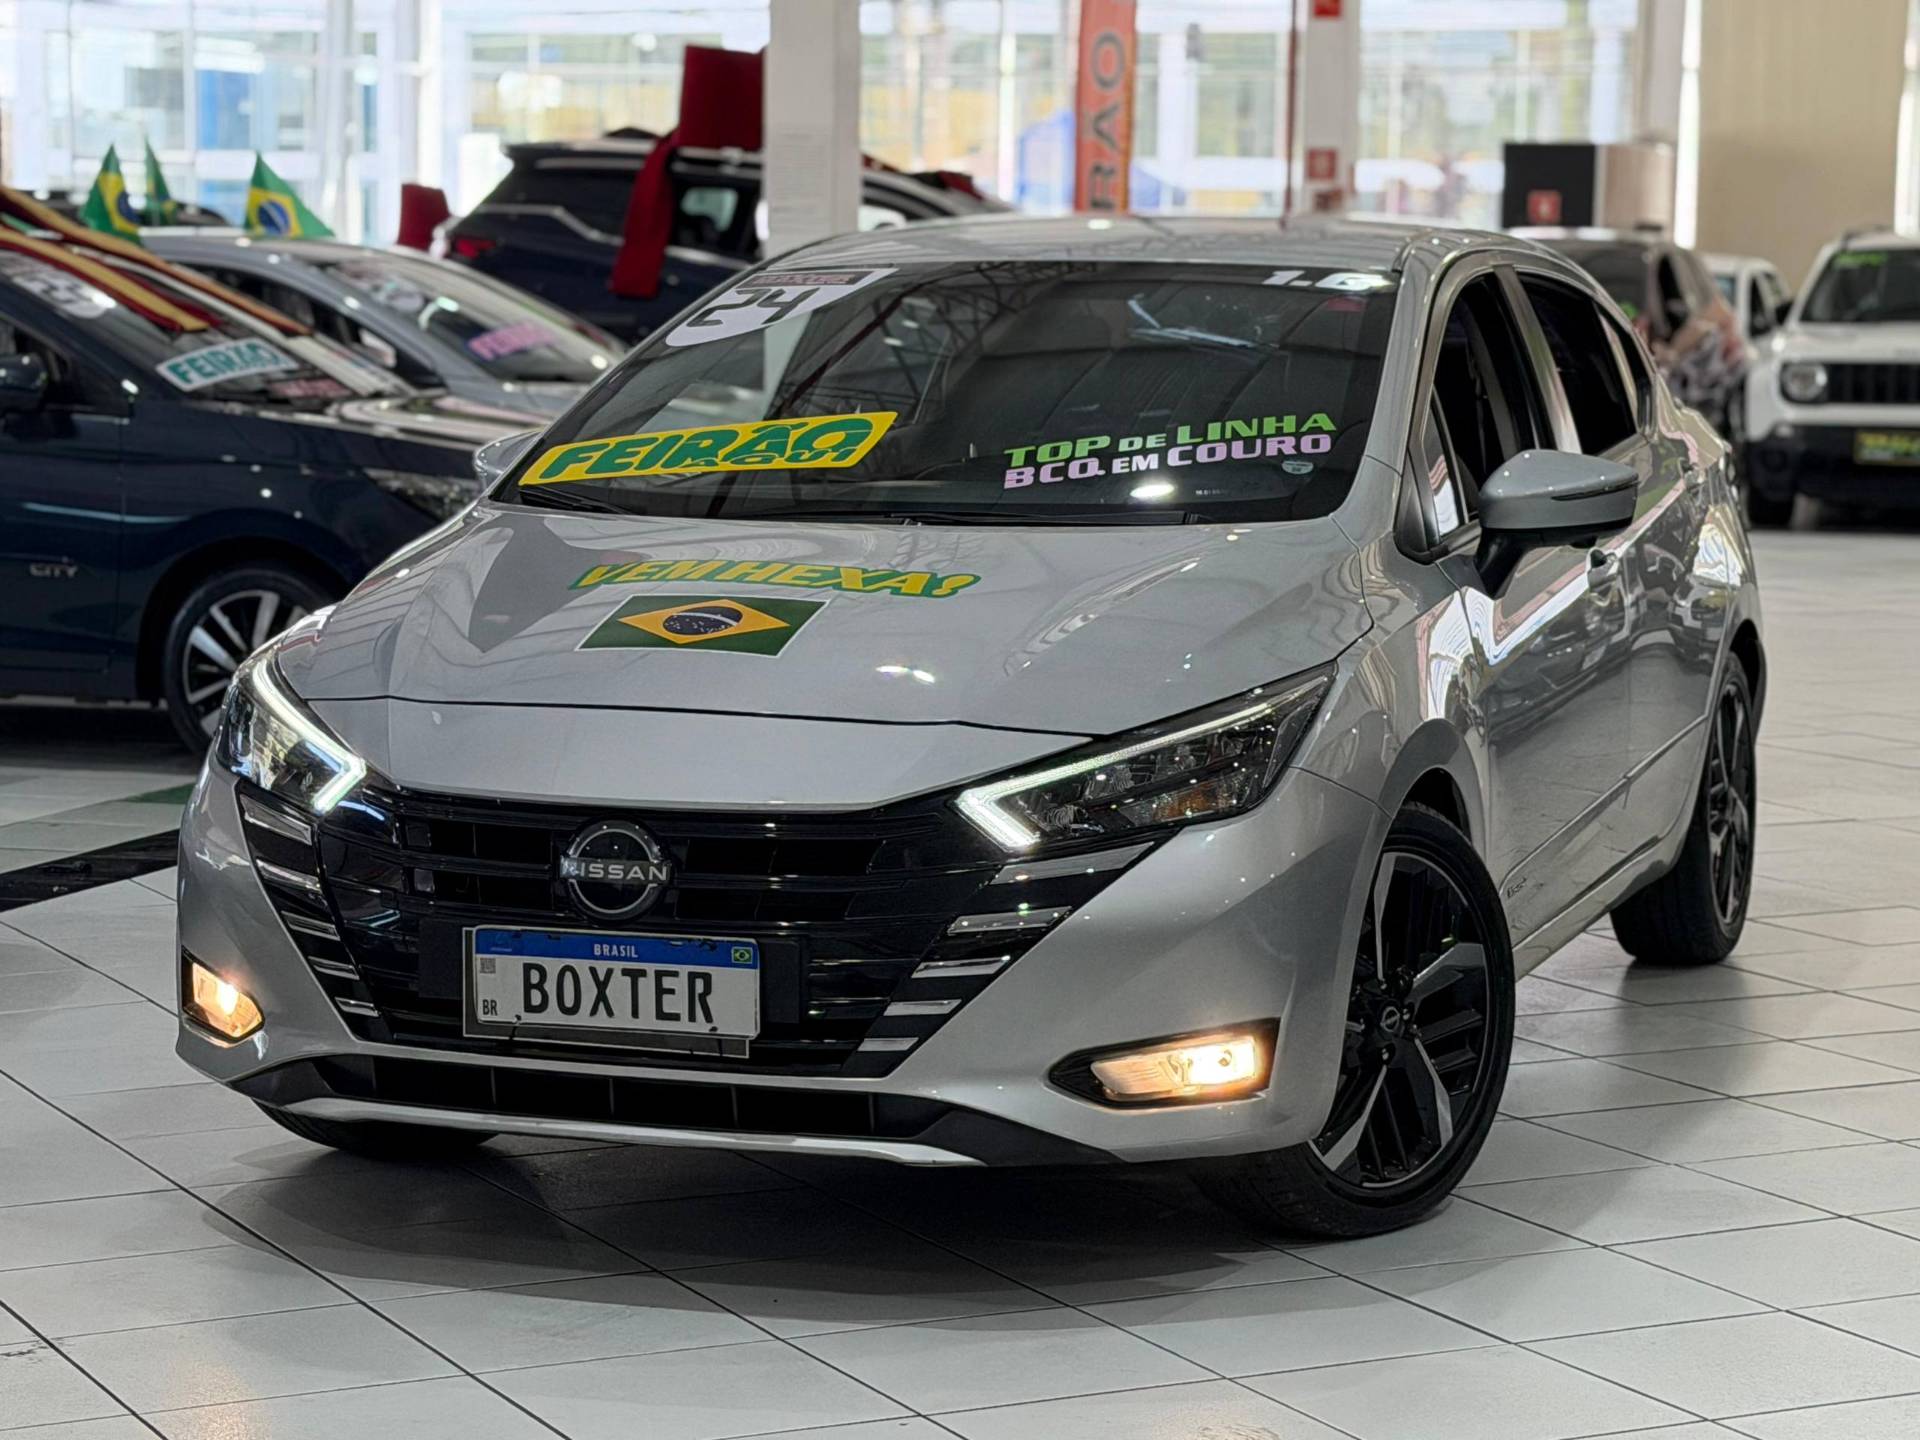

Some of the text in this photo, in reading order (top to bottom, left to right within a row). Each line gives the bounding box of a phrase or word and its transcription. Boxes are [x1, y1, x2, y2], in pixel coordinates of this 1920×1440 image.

[1261, 269, 1391, 291] 1.6
[686, 287, 819, 328] 24
[539, 418, 873, 479] FEIRÃO
[1004, 413, 1336, 467] TOP DE LINHA
[1111, 453, 1159, 474] EM
[1167, 434, 1332, 467] COURO
[570, 559, 726, 589] VEM
[561, 857, 667, 881] NISSAN
[594, 943, 639, 959] BRASIL
[482, 998, 498, 1017] BR
[522, 962, 714, 1024] BOXTER
